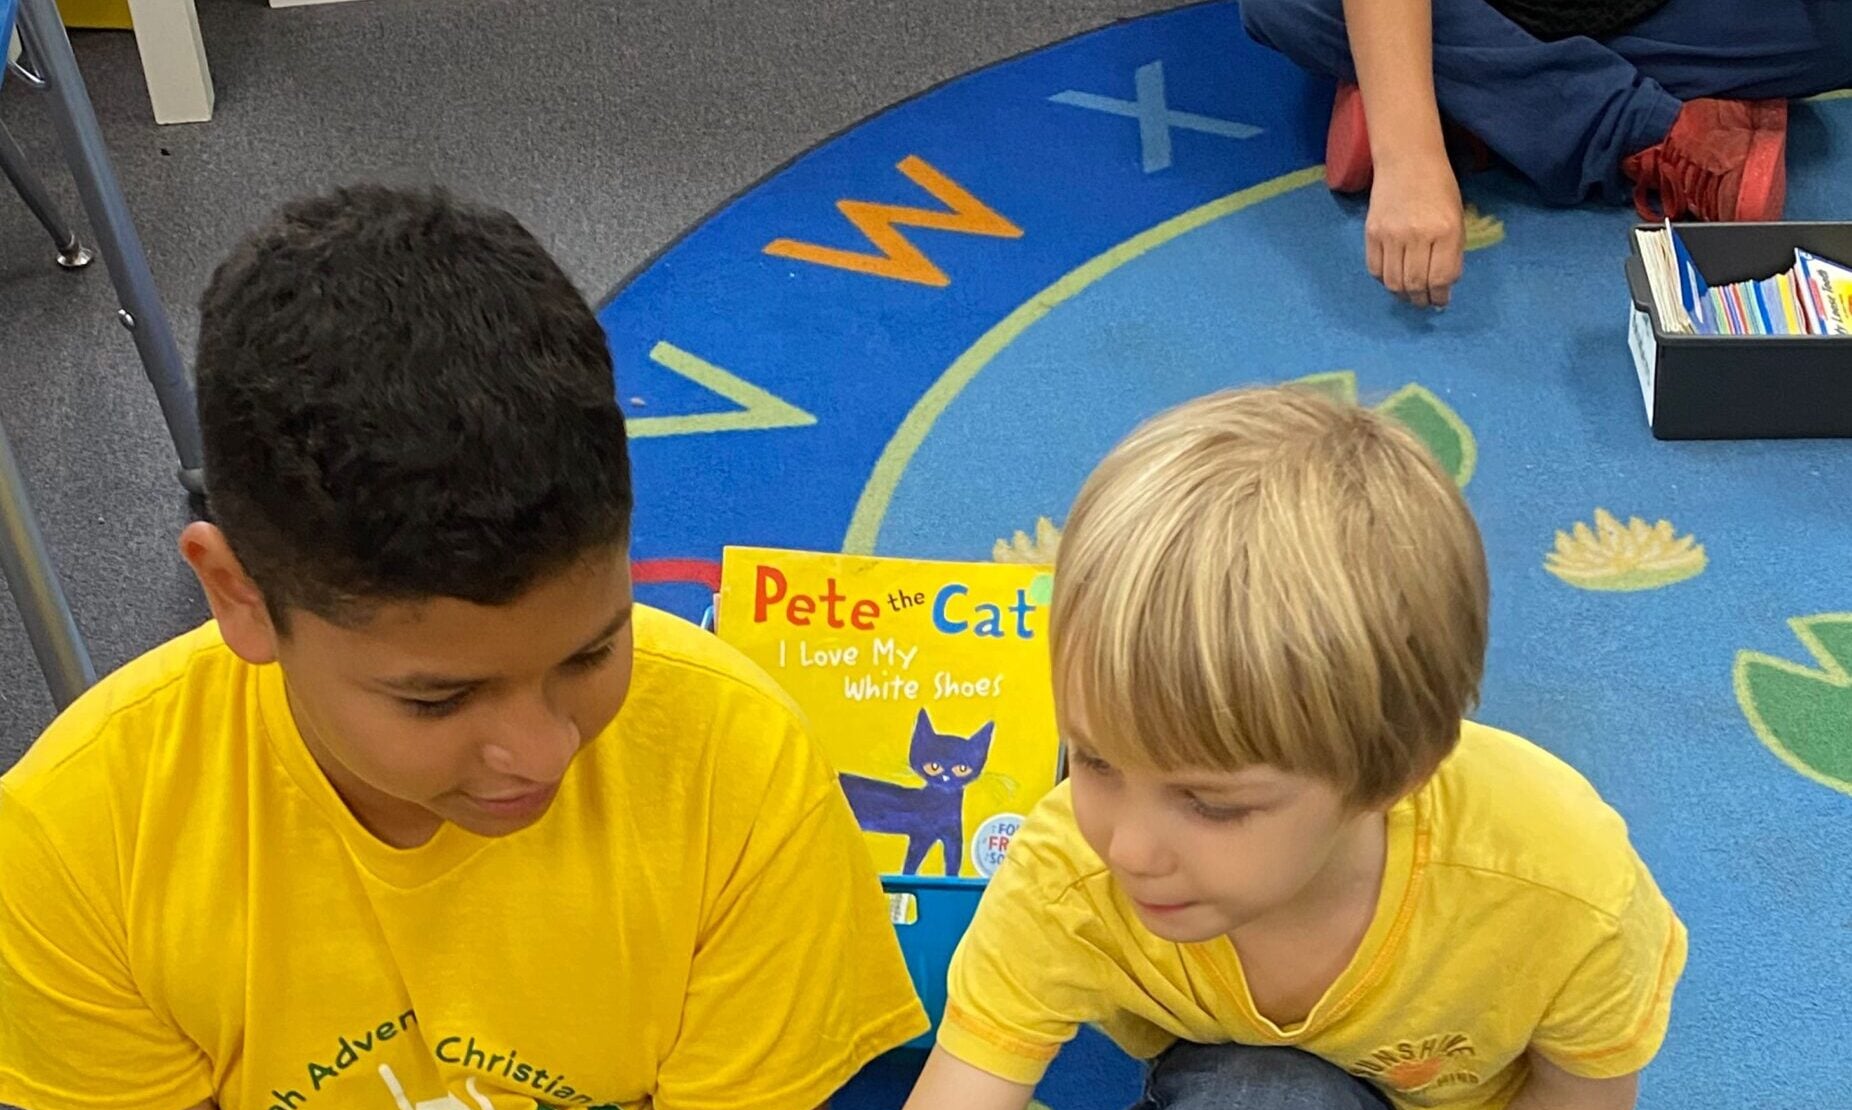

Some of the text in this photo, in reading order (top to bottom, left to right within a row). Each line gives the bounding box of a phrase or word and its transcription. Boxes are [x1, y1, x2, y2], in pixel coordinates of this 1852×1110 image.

[1047, 59, 1265, 174] X
[761, 155, 1024, 288] W
[625, 340, 818, 438] V
[753, 565, 881, 631] Pete
[887, 589, 926, 611] the
[931, 583, 1036, 640] Cat
[779, 637, 918, 670] I Love My
[844, 671, 1004, 702] White Shoes
[998, 823, 1019, 837] FO
